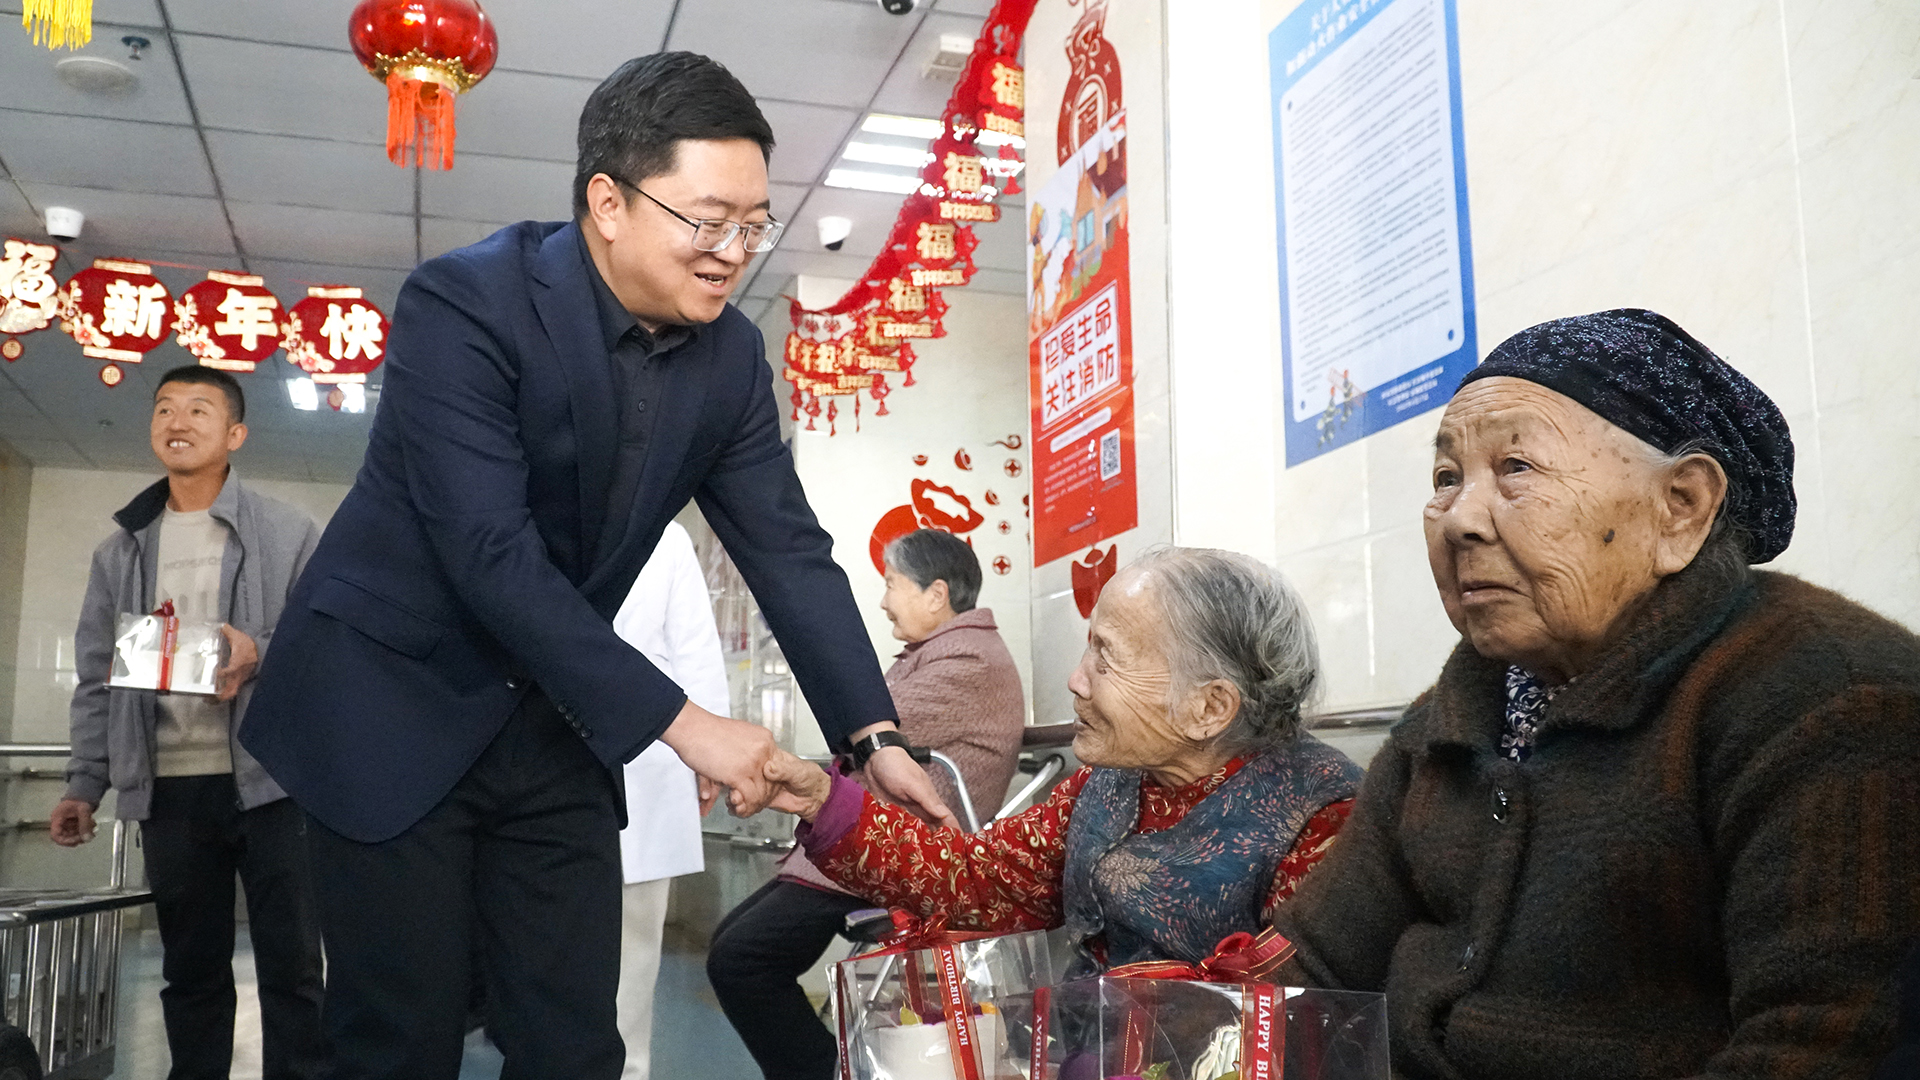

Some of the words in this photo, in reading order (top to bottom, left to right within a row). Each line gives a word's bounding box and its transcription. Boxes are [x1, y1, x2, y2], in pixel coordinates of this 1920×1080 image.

[942, 151, 984, 194] 福
[916, 222, 956, 260] 福
[888, 277, 926, 313] 福
[1046, 343, 1114, 418] 关注消防
[942, 949, 961, 1006] BIRTHDAY
[954, 1009, 969, 1046] HAPPY
[1257, 994, 1272, 1053] HAPPY
